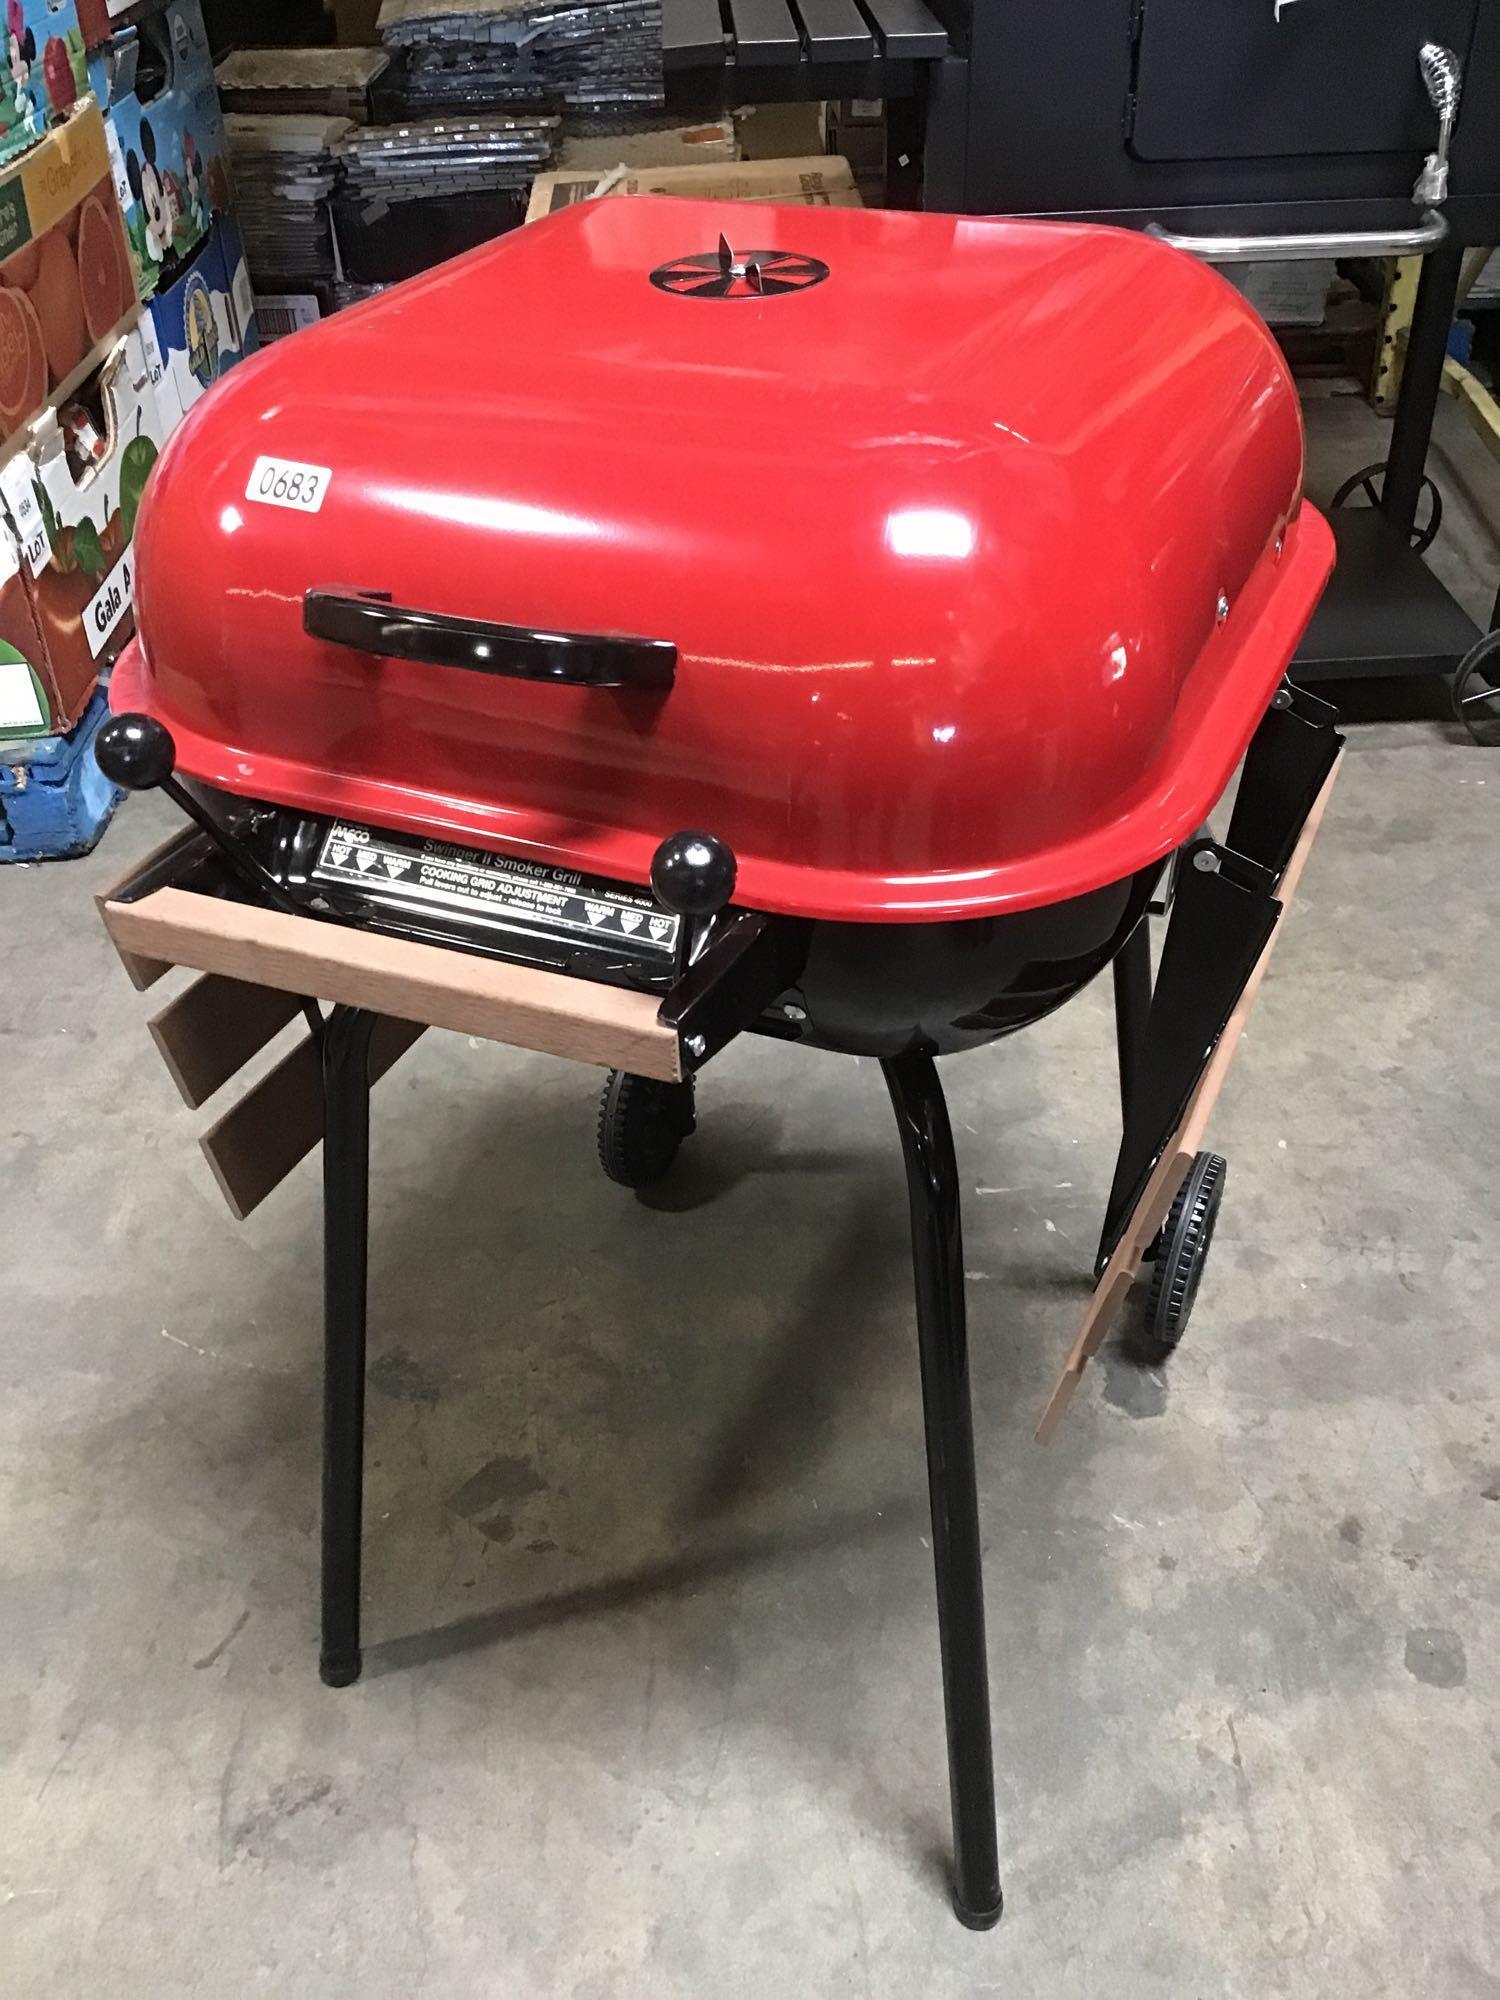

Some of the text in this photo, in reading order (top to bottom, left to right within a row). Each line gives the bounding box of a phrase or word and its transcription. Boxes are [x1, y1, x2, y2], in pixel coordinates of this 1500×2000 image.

[150, 364, 162, 385] LOT
[259, 466, 319, 504] 0683
[27, 530, 45, 564] LOT
[95, 586, 122, 633] Gala
[332, 844, 411, 869] HOT MED WARM
[423, 840, 480, 862] Swinger
[494, 856, 549, 878] Smoker
[552, 869, 582, 885] Grill
[420, 876, 434, 886] Pull
[435, 880, 456, 891] levers
[456, 884, 469, 894] out
[470, 887, 478, 896] to
[479, 890, 502, 902] adjust
[535, 903, 544, 911] to
[544, 905, 562, 915] lock
[421, 866, 568, 907] COOKING GRID ADJUSTMENT
[584, 903, 672, 930] WARM MED HOT
